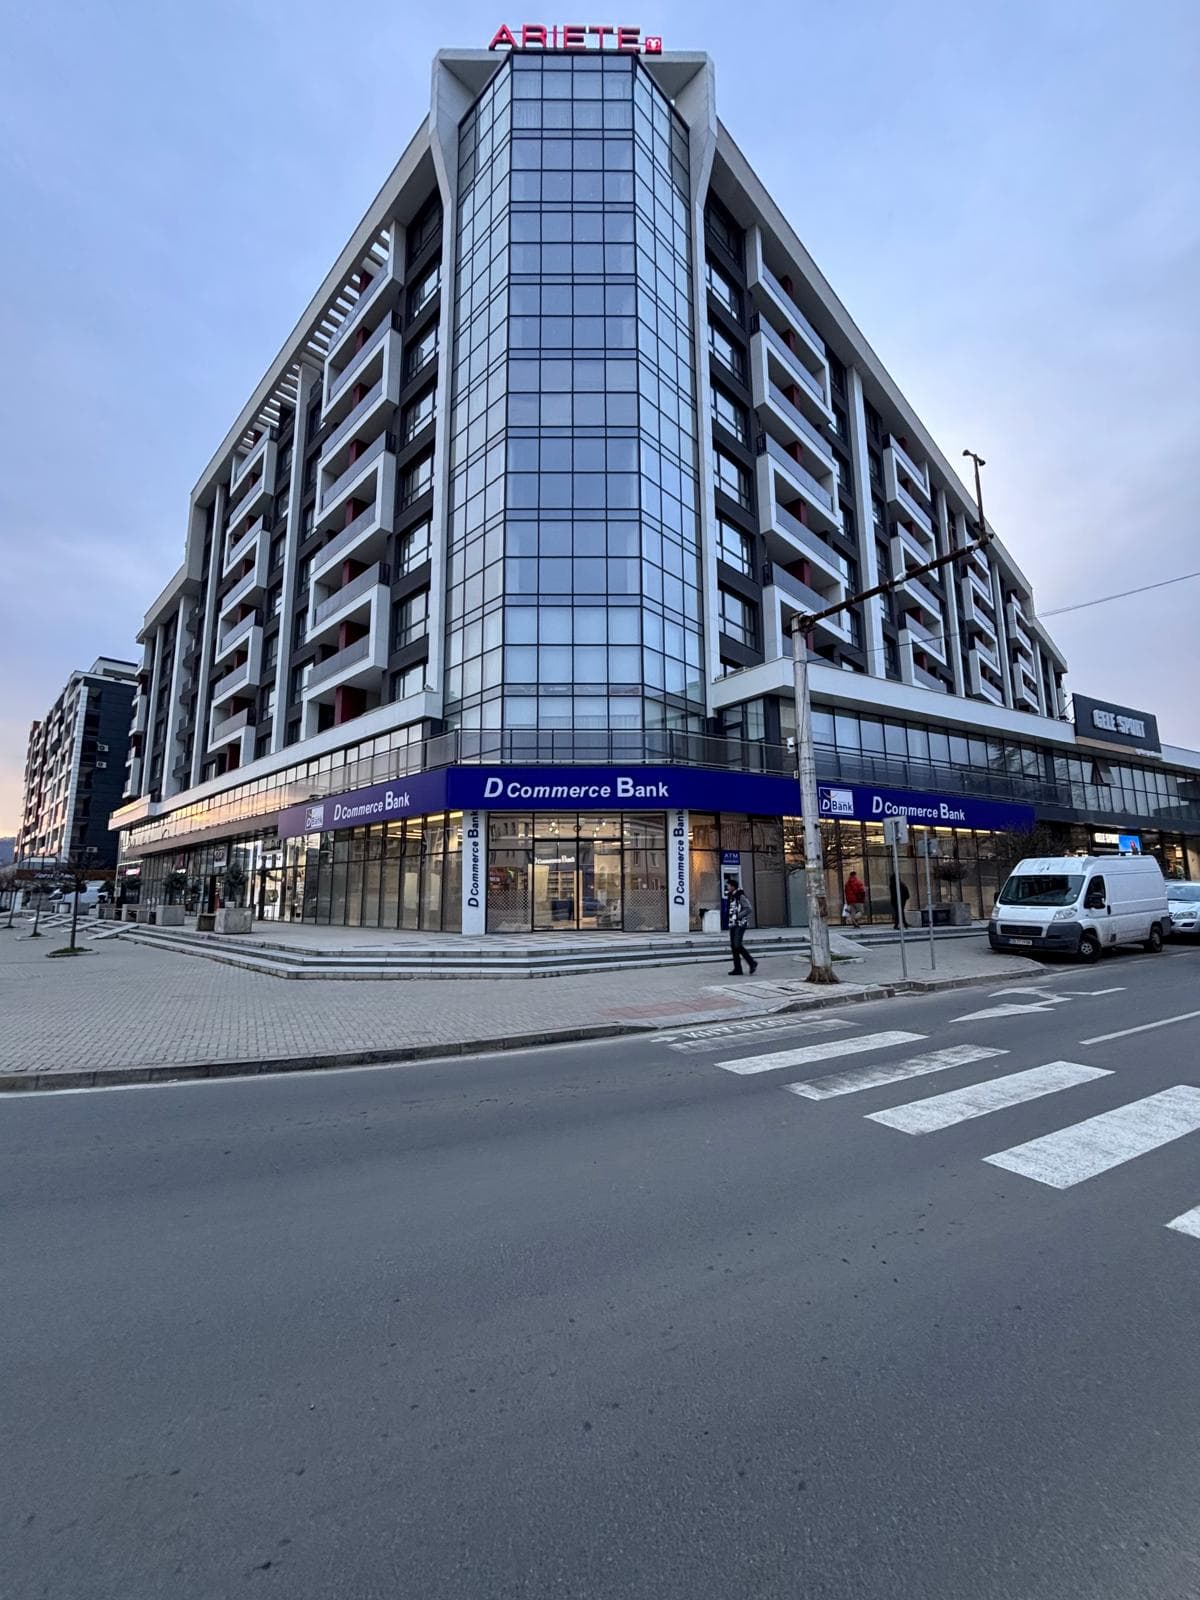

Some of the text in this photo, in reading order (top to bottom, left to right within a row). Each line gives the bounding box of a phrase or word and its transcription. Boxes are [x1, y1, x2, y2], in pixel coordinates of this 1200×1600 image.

[489, 24, 641, 53] ARIETE
[484, 777, 669, 798] D Commerce Bank
[333, 791, 410, 822] D Commerce Bank
[872, 796, 966, 821] D Commerce Bank
[468, 810, 480, 908] D Commerce Bank
[673, 810, 685, 905] D Commerce Bank
